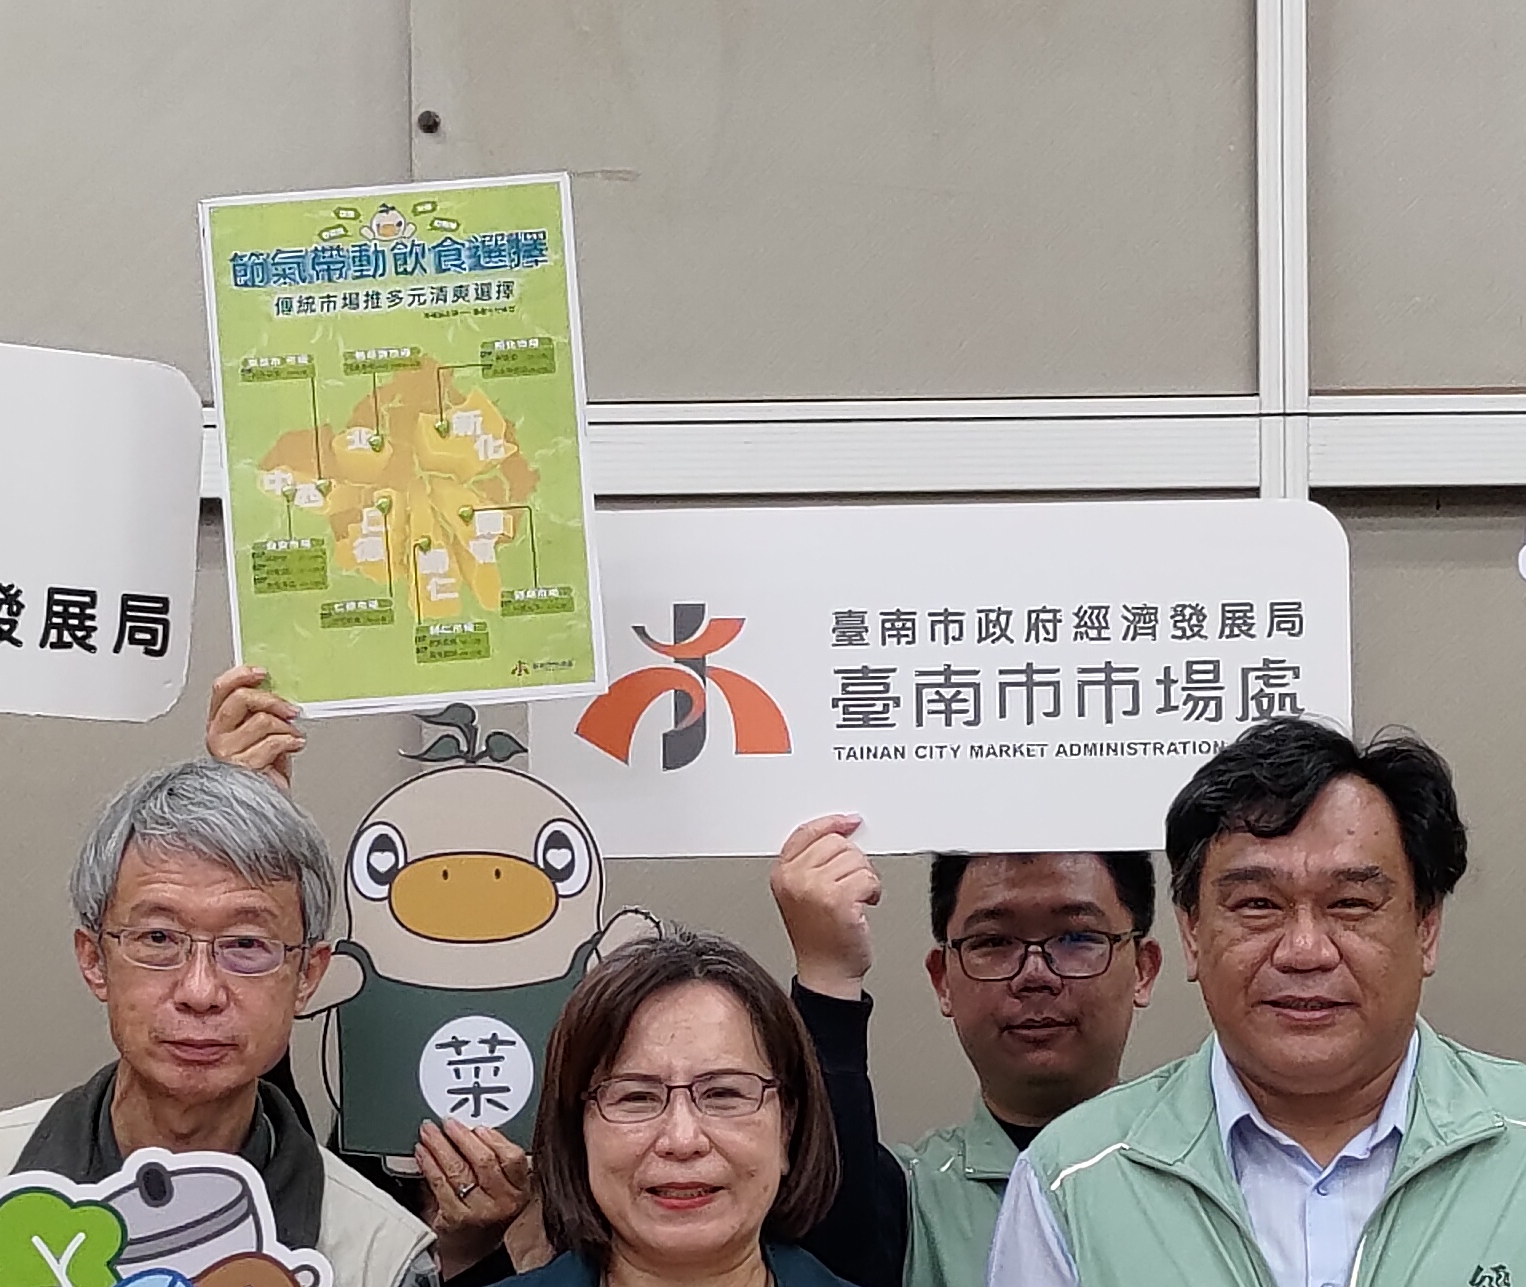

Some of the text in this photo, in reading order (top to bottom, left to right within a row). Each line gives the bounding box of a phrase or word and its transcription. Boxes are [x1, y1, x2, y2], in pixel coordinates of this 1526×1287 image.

[830, 601, 1305, 648] 臺南市政府經濟發展局
[832, 658, 1306, 730] 臺南市市場處
[834, 740, 1225, 761] TAINAN CITY MARKET ADMINISTRATION
[435, 1032, 516, 1118] 菜
